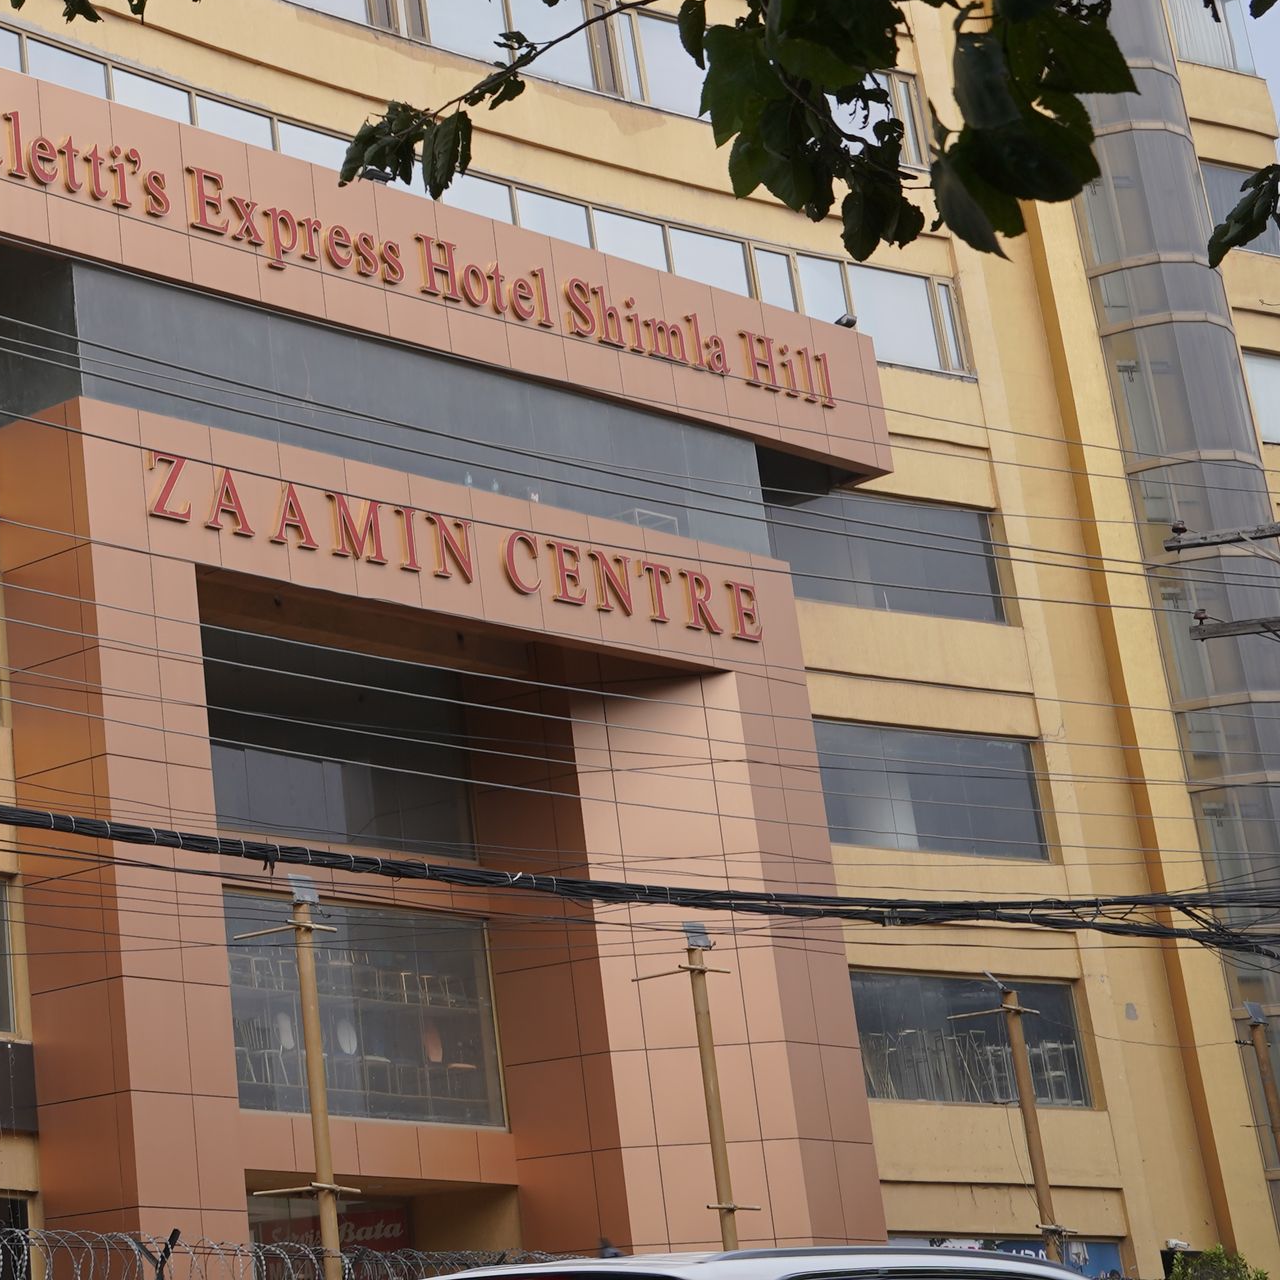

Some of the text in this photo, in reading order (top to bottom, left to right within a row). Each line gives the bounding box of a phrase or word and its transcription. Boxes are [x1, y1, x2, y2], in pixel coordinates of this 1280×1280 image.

[185, 165, 405, 286] Express
[413, 232, 555, 328] Hotel
[564, 277, 731, 376] Shimla
[738, 329, 838, 410] Hill
[148, 449, 765, 644] ZAAMIN CENTRE
[341, 1219, 403, 1242] Bata
